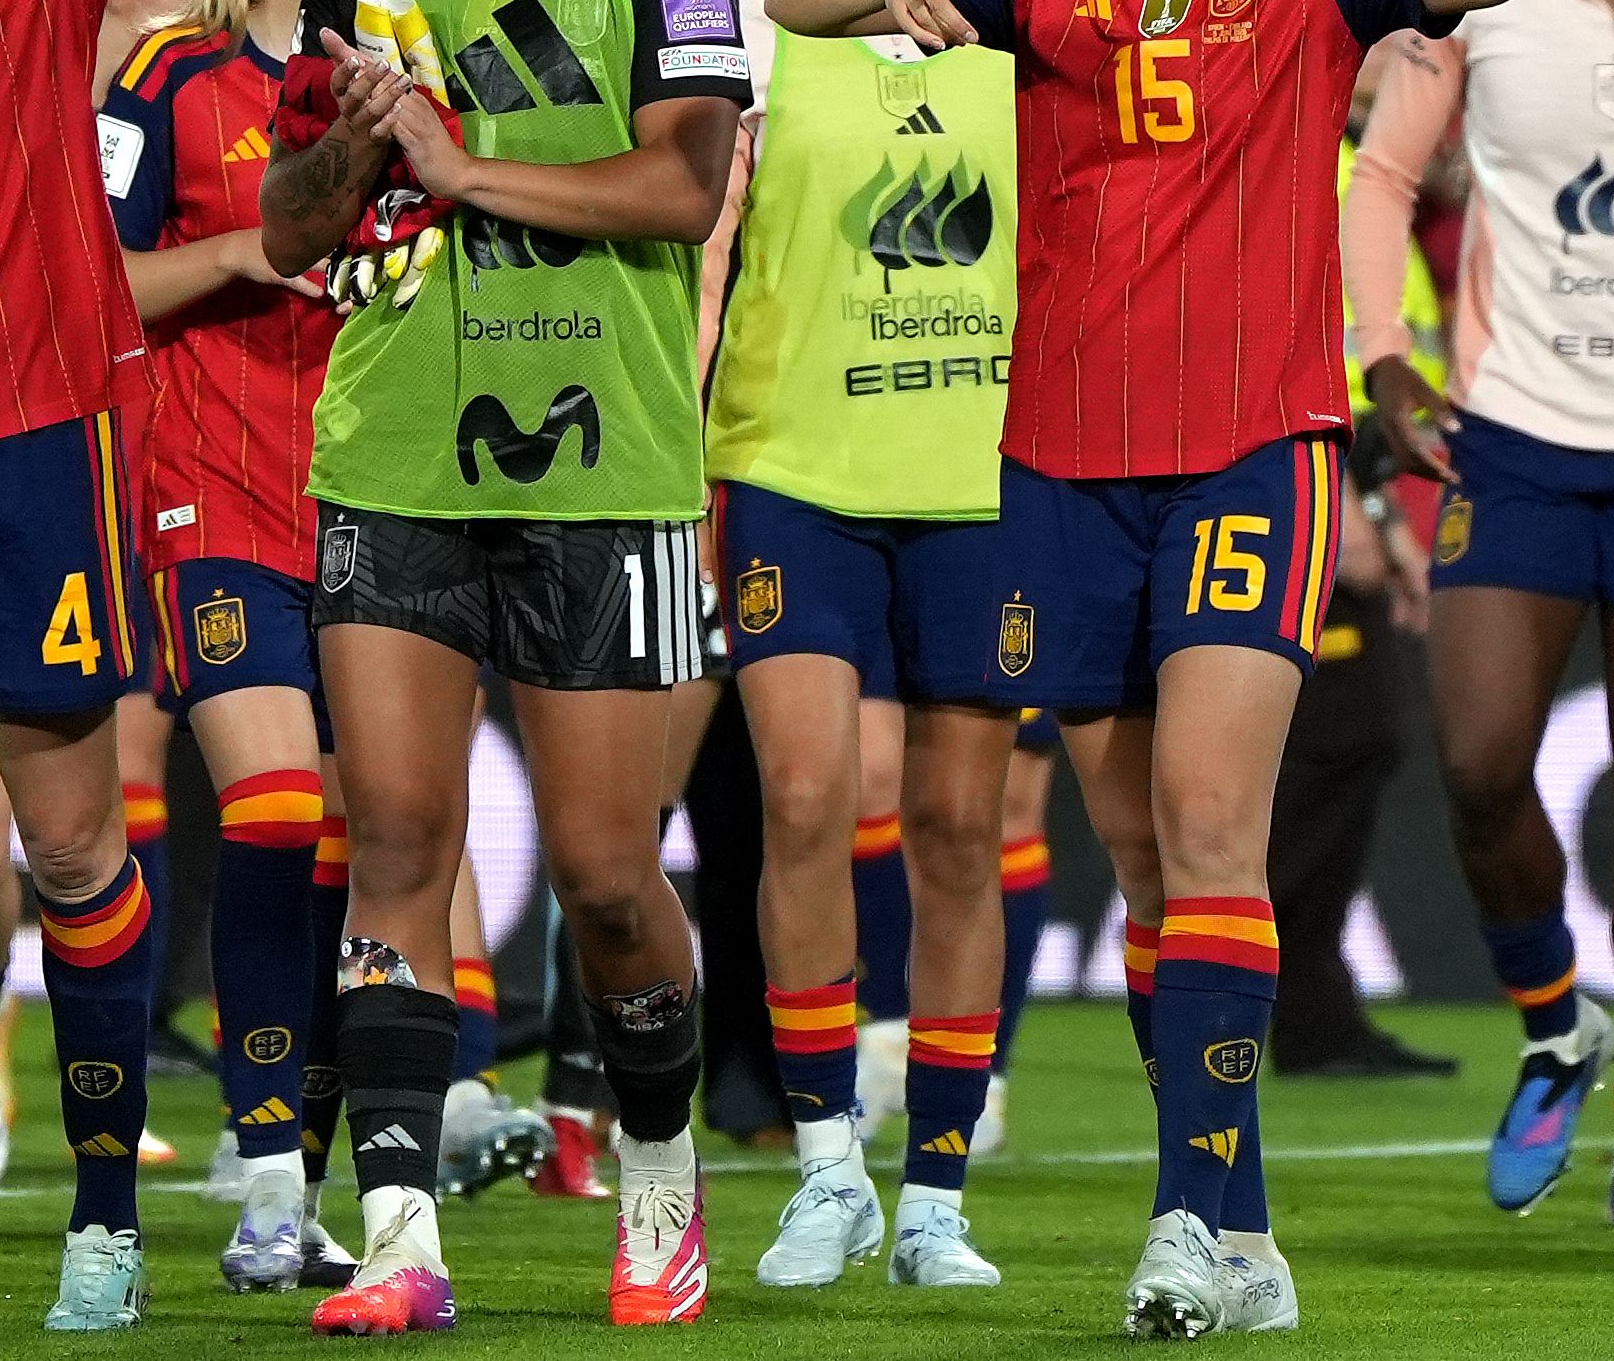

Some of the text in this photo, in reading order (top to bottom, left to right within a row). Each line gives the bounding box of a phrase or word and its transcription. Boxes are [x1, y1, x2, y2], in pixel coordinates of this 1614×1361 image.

[673, 10, 727, 22] EUROPEAN
[673, 20, 729, 32] QUALIFIERS
[662, 54, 746, 69] FOUNDATION
[1114, 38, 1195, 144] 15
[462, 309, 603, 341] berdrola
[871, 305, 1004, 340] Iberdrola
[1185, 514, 1272, 616] 15
[623, 553, 646, 658] 1
[41, 571, 102, 676] 4
